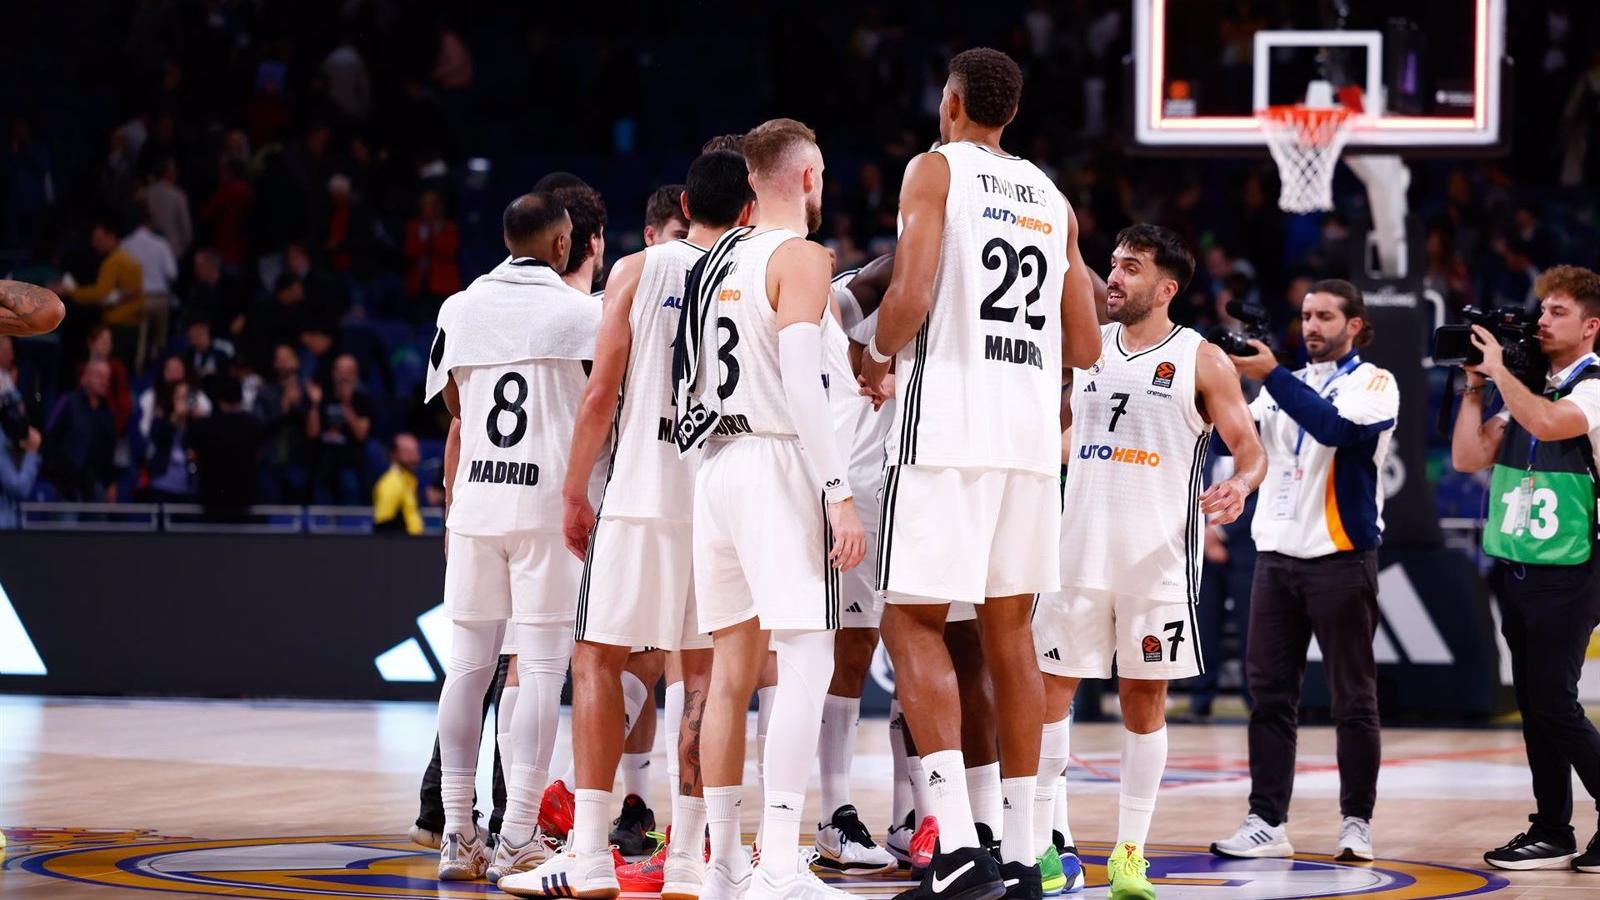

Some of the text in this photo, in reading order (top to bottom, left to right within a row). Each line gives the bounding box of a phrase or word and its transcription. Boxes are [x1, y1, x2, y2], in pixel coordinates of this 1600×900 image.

[976, 173, 1047, 207] TAVARES
[979, 237, 1048, 330] 22
[486, 371, 528, 449] 8
[1108, 392, 1131, 433] 7
[468, 460, 540, 487] MADRID
[1078, 444, 1161, 468] UTOHERO
[1500, 486, 1559, 540] 13
[1163, 620, 1185, 662] 7
